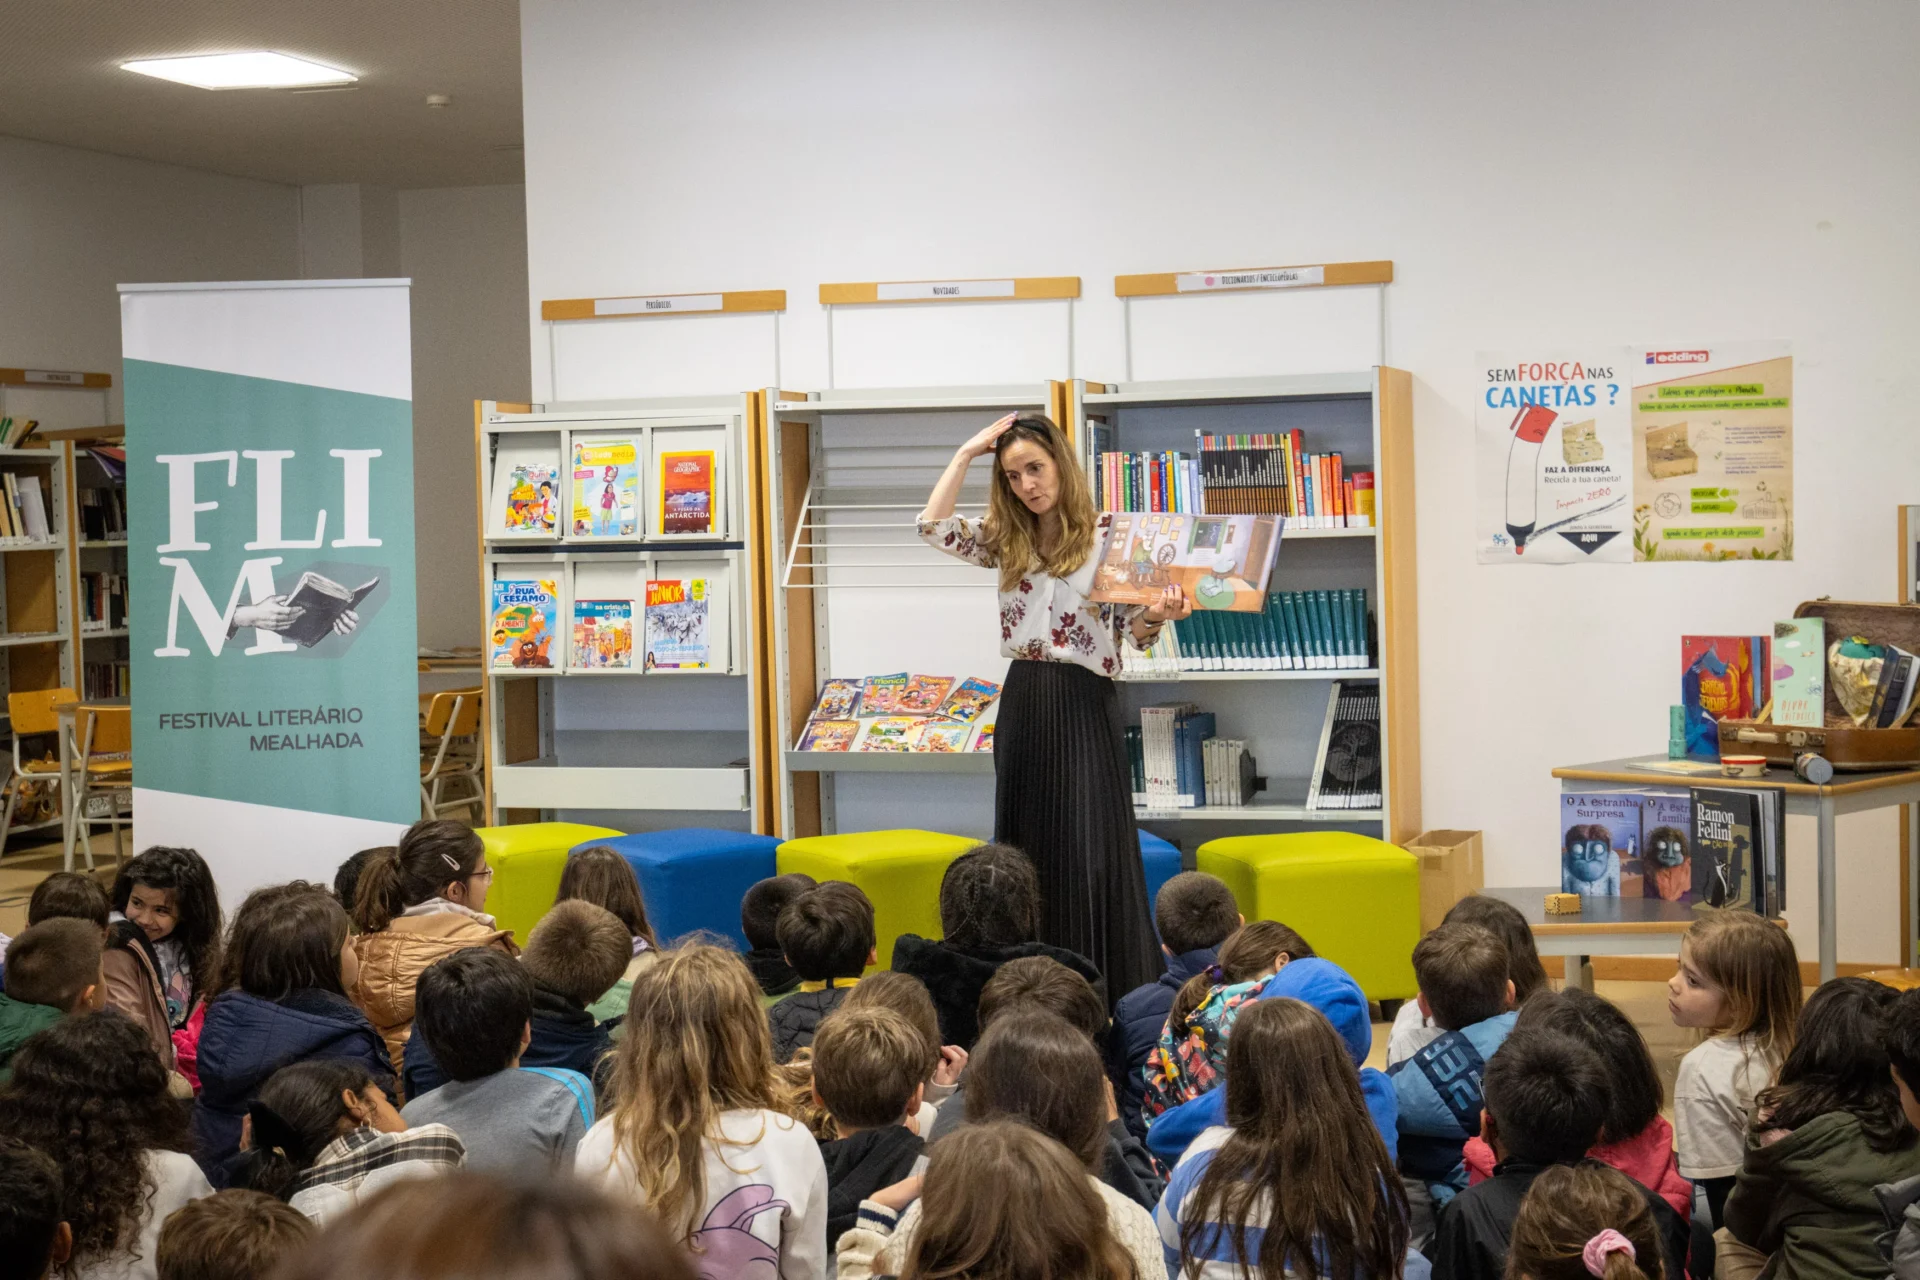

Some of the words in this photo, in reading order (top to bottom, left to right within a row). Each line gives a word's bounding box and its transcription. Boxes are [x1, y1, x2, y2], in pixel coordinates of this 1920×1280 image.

[1657, 352, 1707, 363] edding
[1487, 369, 1517, 382] SEM
[1518, 362, 1585, 386] FORÇA
[1587, 367, 1614, 379] NAS
[1485, 384, 1597, 409] CANETAS
[1607, 383, 1620, 406] ?
[1544, 466, 1559, 474] FAZ
[1568, 465, 1611, 475] DIFERENÇA
[1544, 476, 1570, 484] Recicla
[1586, 487, 1612, 501] ZERO
[155, 448, 384, 554] FLI
[664, 511, 710, 519] ANTÁRCTIDA
[1580, 533, 1598, 543] AQUI
[515, 587, 536, 595] RUA
[159, 713, 252, 730] FESTIVAL
[257, 705, 364, 728] LITERÁRIO
[249, 732, 364, 752] MEALHADA
[1577, 797, 1587, 807] A
[1591, 798, 1639, 808] estranha
[1658, 802, 1666, 812] A
[1669, 803, 1691, 813] estr
[1696, 803, 1735, 825] Ramon
[1696, 820, 1733, 842] Fellini
